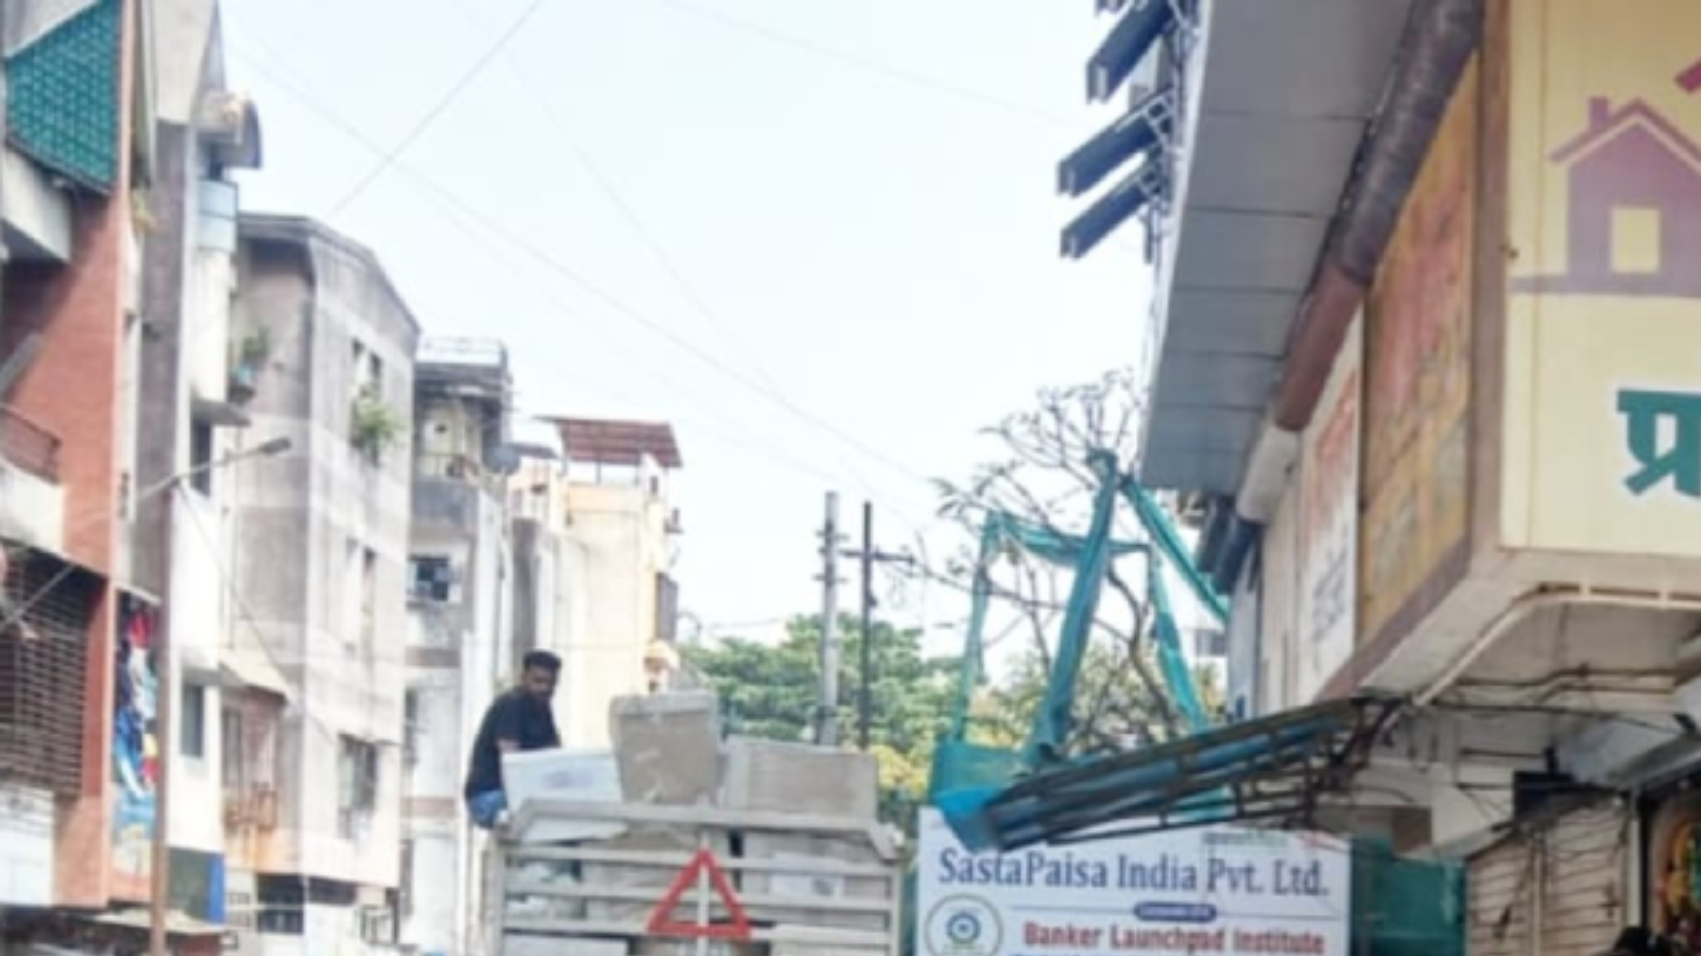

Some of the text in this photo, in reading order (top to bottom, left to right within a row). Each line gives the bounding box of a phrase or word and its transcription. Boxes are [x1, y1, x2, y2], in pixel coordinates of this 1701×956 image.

[938, 848, 1331, 898] SastaPaisa India Pvt. Ltd.
[1023, 920, 1103, 949] Banker
